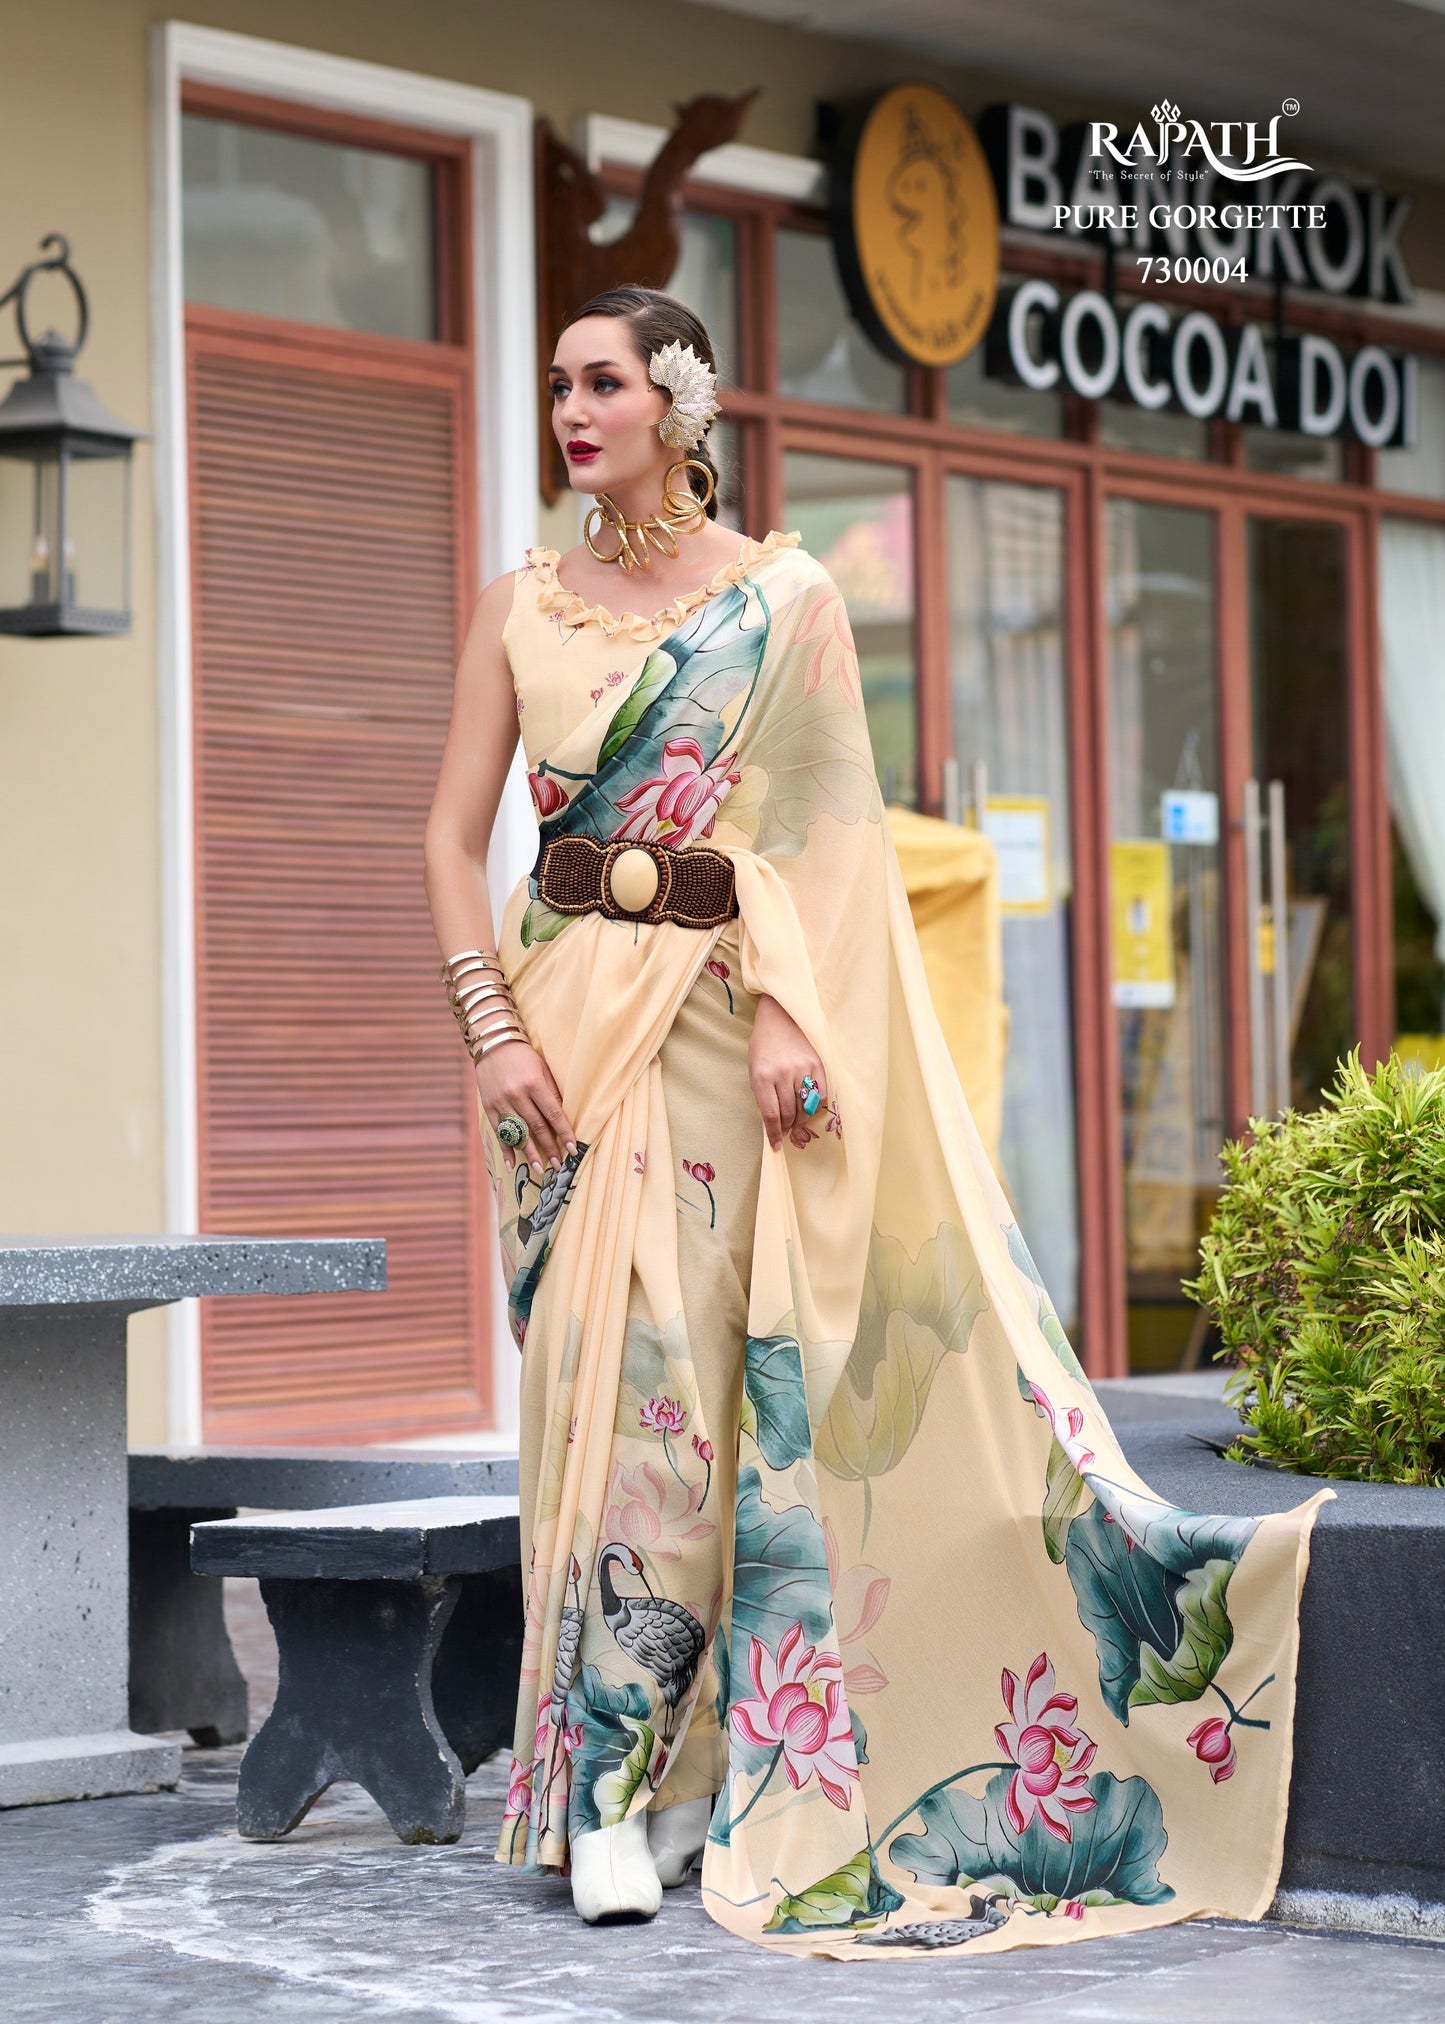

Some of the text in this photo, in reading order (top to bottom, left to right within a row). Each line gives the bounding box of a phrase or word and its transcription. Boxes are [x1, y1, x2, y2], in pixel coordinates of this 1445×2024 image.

[1008, 106, 1413, 301] BANGKOK
[1009, 282, 1276, 427] COCOA
[1300, 334, 1418, 448] DOI
